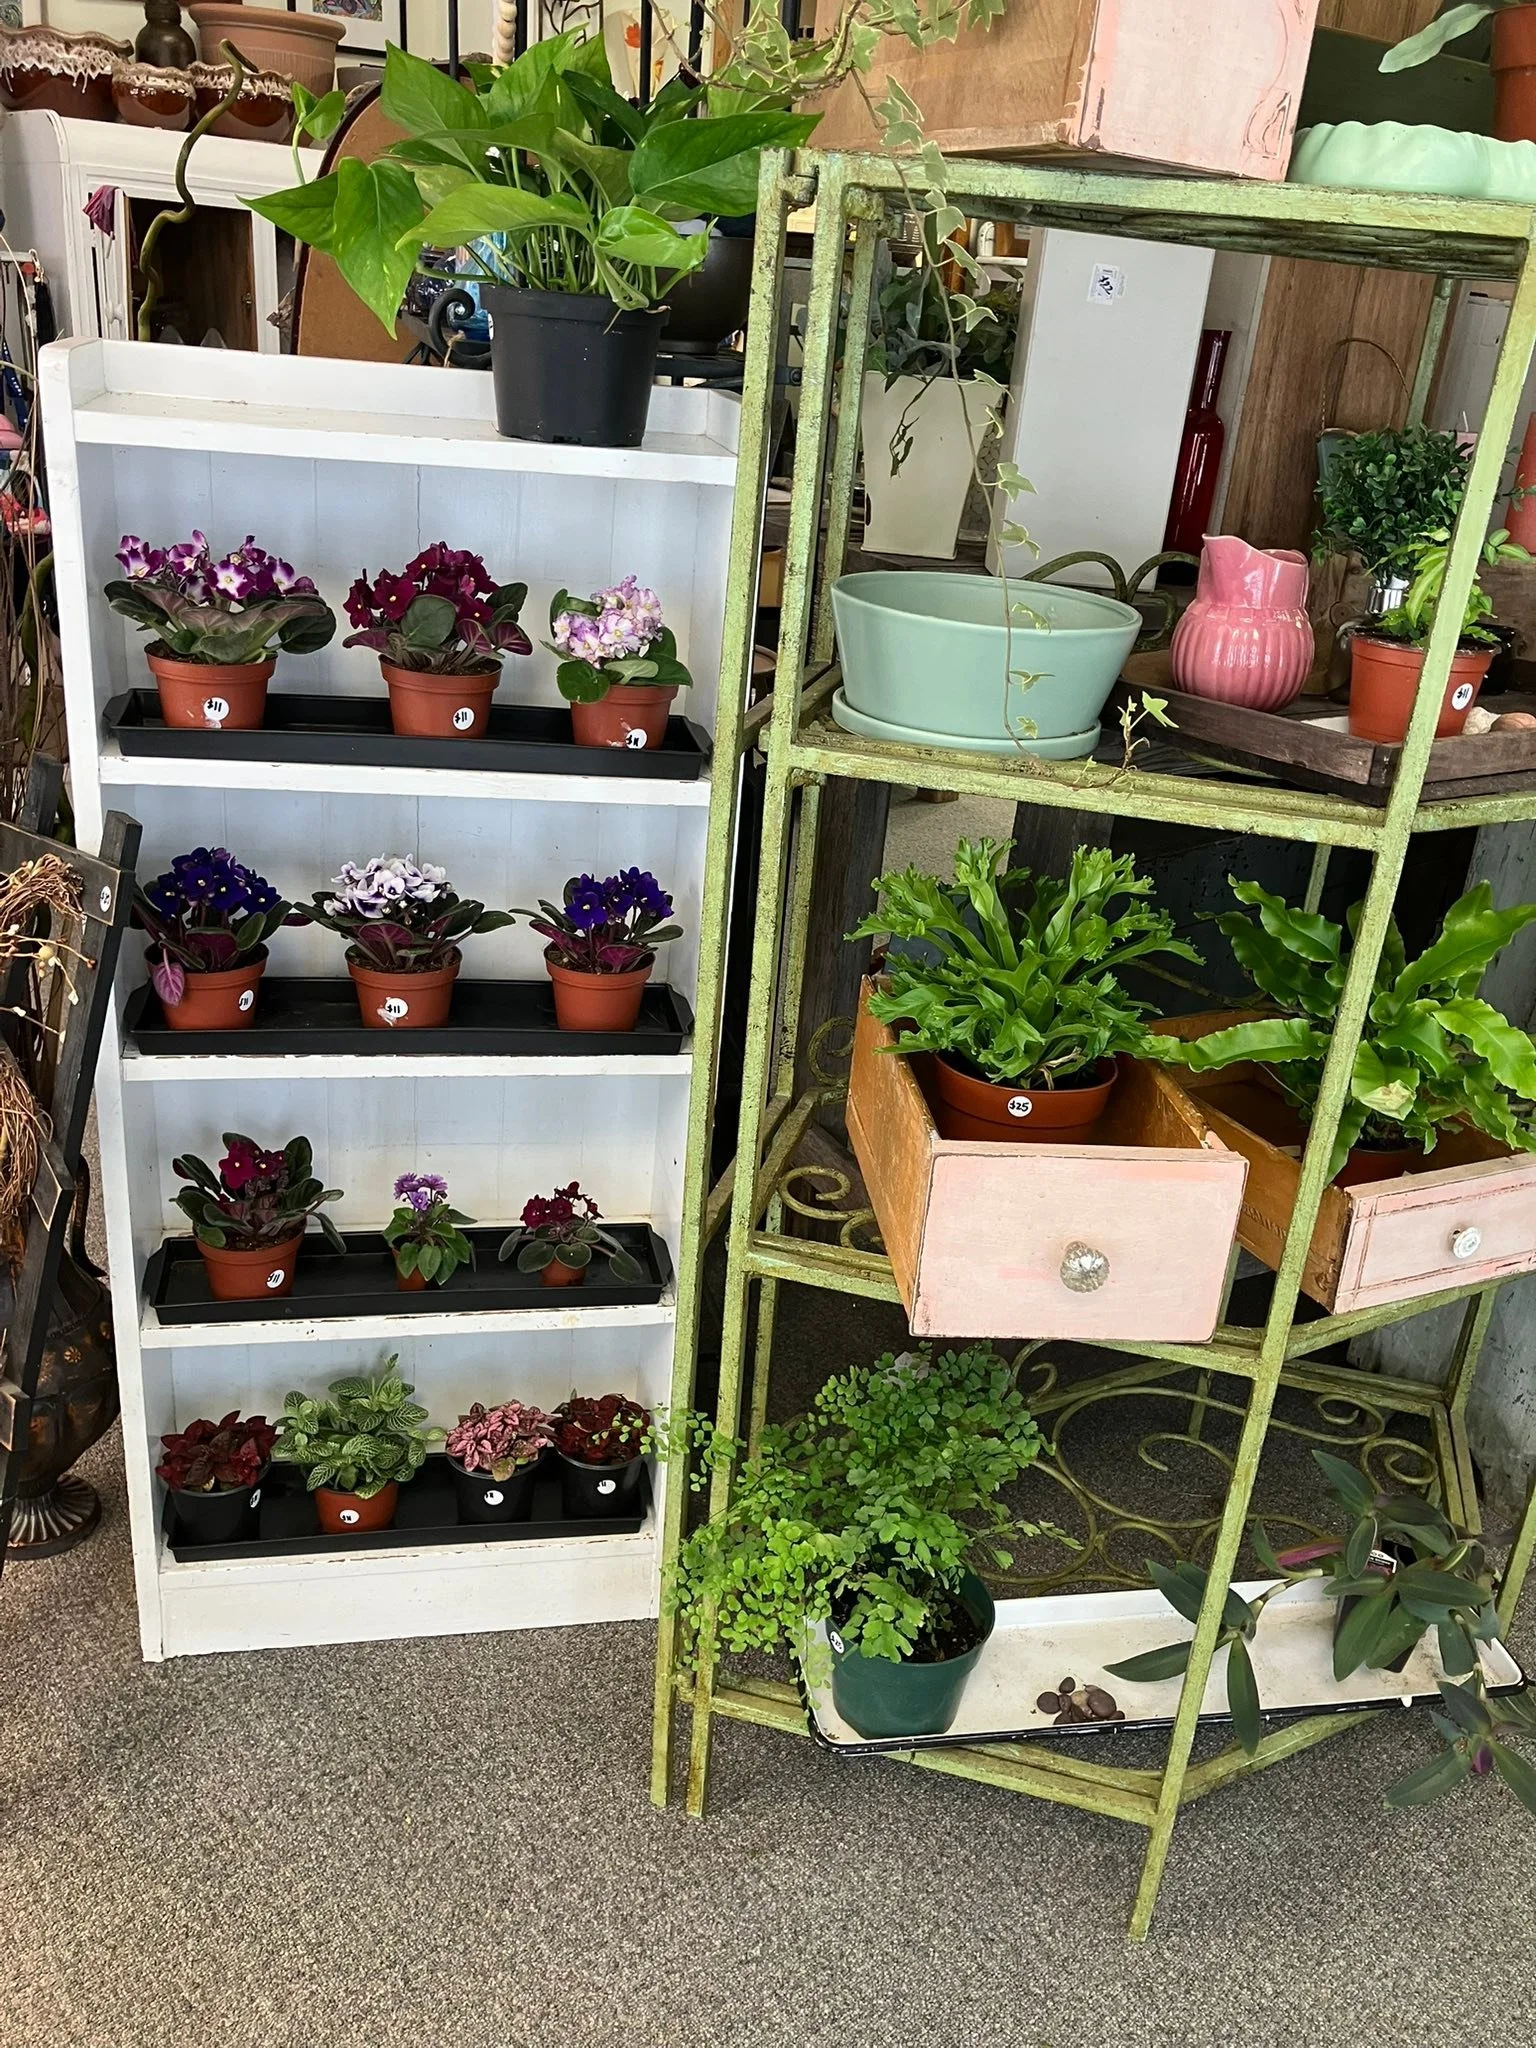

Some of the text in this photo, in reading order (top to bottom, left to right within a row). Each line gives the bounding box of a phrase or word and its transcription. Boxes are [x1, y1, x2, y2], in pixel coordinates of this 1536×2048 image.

[1457, 687, 1470, 699] $11
[207, 698, 222, 712] $11
[455, 711, 467, 724] $11
[387, 1004, 400, 1013] $11
[1009, 1100, 1029, 1112] $25
